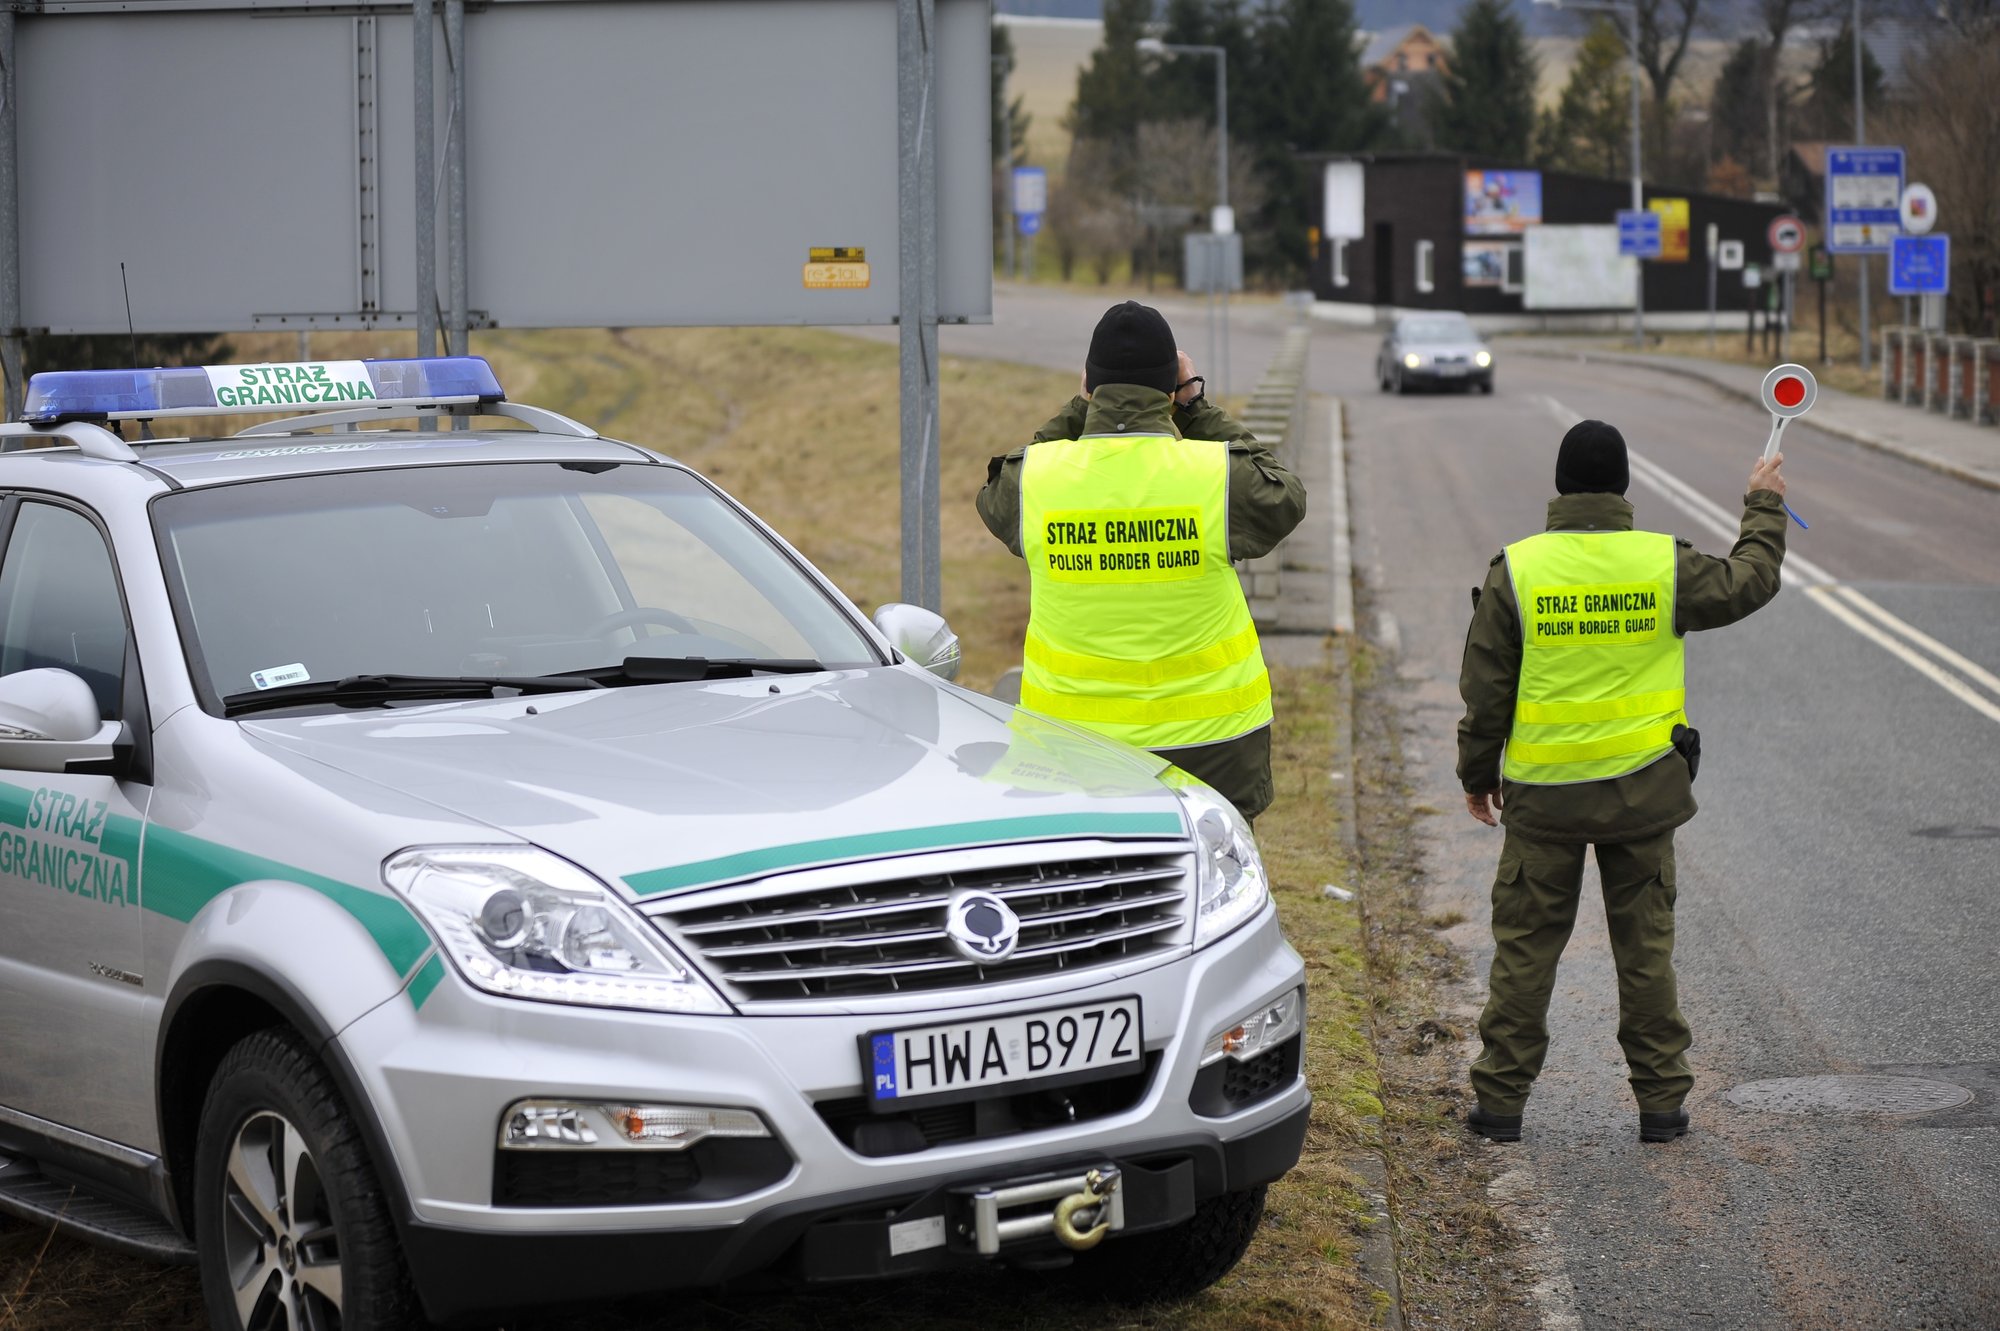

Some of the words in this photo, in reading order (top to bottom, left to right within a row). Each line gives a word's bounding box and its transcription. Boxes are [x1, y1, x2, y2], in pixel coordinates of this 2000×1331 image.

[239, 365, 330, 385] STRAŻ
[217, 381, 375, 406] GRANICZNA
[1047, 522, 1097, 545] STRAŻ
[1105, 518, 1199, 543] GRANICZNA
[1049, 554, 1093, 571] POLISH
[1100, 552, 1150, 570] BORDER
[1157, 550, 1200, 569] GUARD
[1537, 595, 1578, 614] STRAŻ
[1584, 592, 1657, 612] GRANICZNA
[1537, 621, 1573, 636] POLISH
[1579, 620, 1620, 635] BORDER
[1625, 617, 1656, 633] GUARD
[28, 787, 108, 844] STRAŻ
[0, 831, 125, 907] GRANICZNA
[904, 1027, 1008, 1089] HWA
[1026, 1007, 1133, 1072] B972
[876, 1074, 895, 1091] PL
